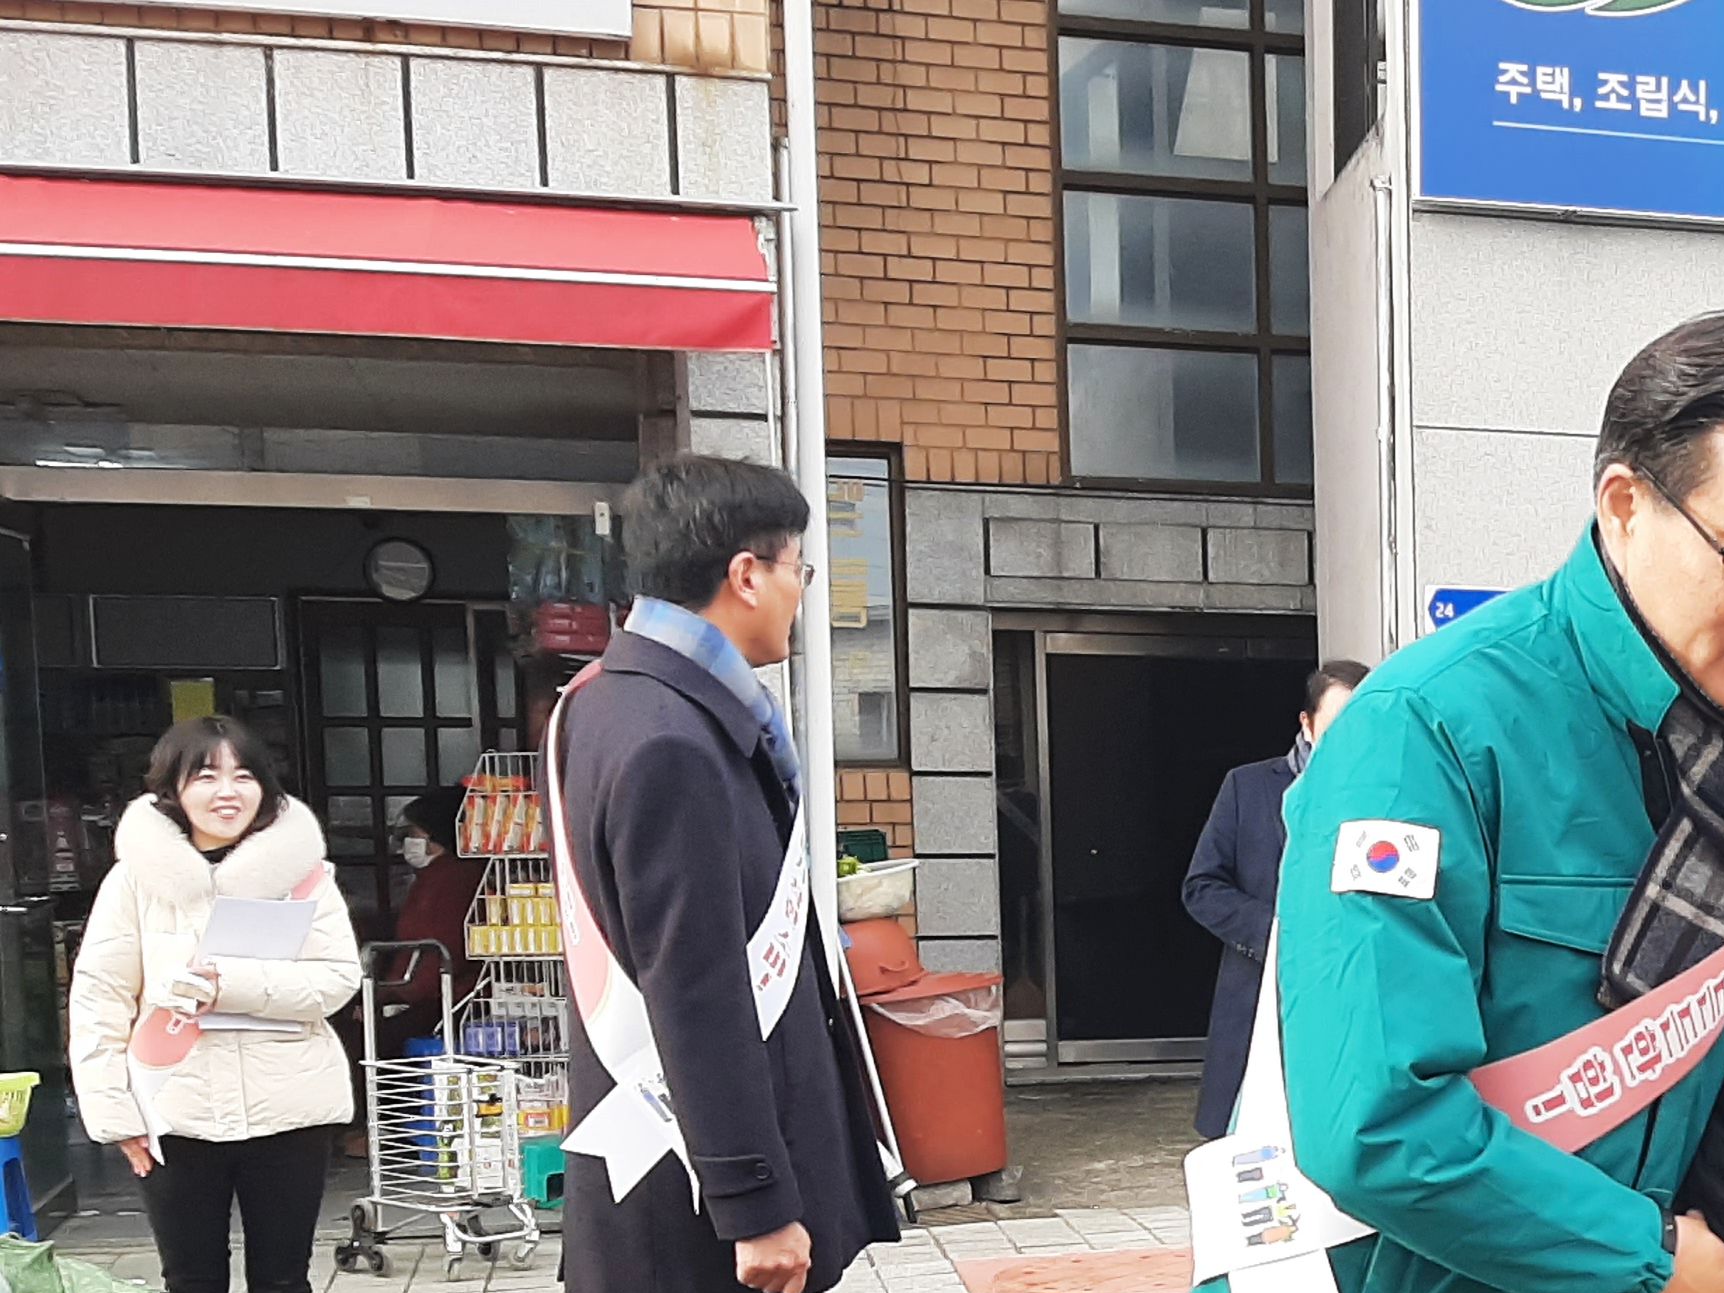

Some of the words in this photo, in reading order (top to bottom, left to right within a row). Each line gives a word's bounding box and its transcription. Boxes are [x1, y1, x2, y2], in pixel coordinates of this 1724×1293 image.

[1495, 62, 1582, 112] 주택,
[1594, 72, 1718, 125] 조립식,
[1435, 602, 1455, 618] 24
